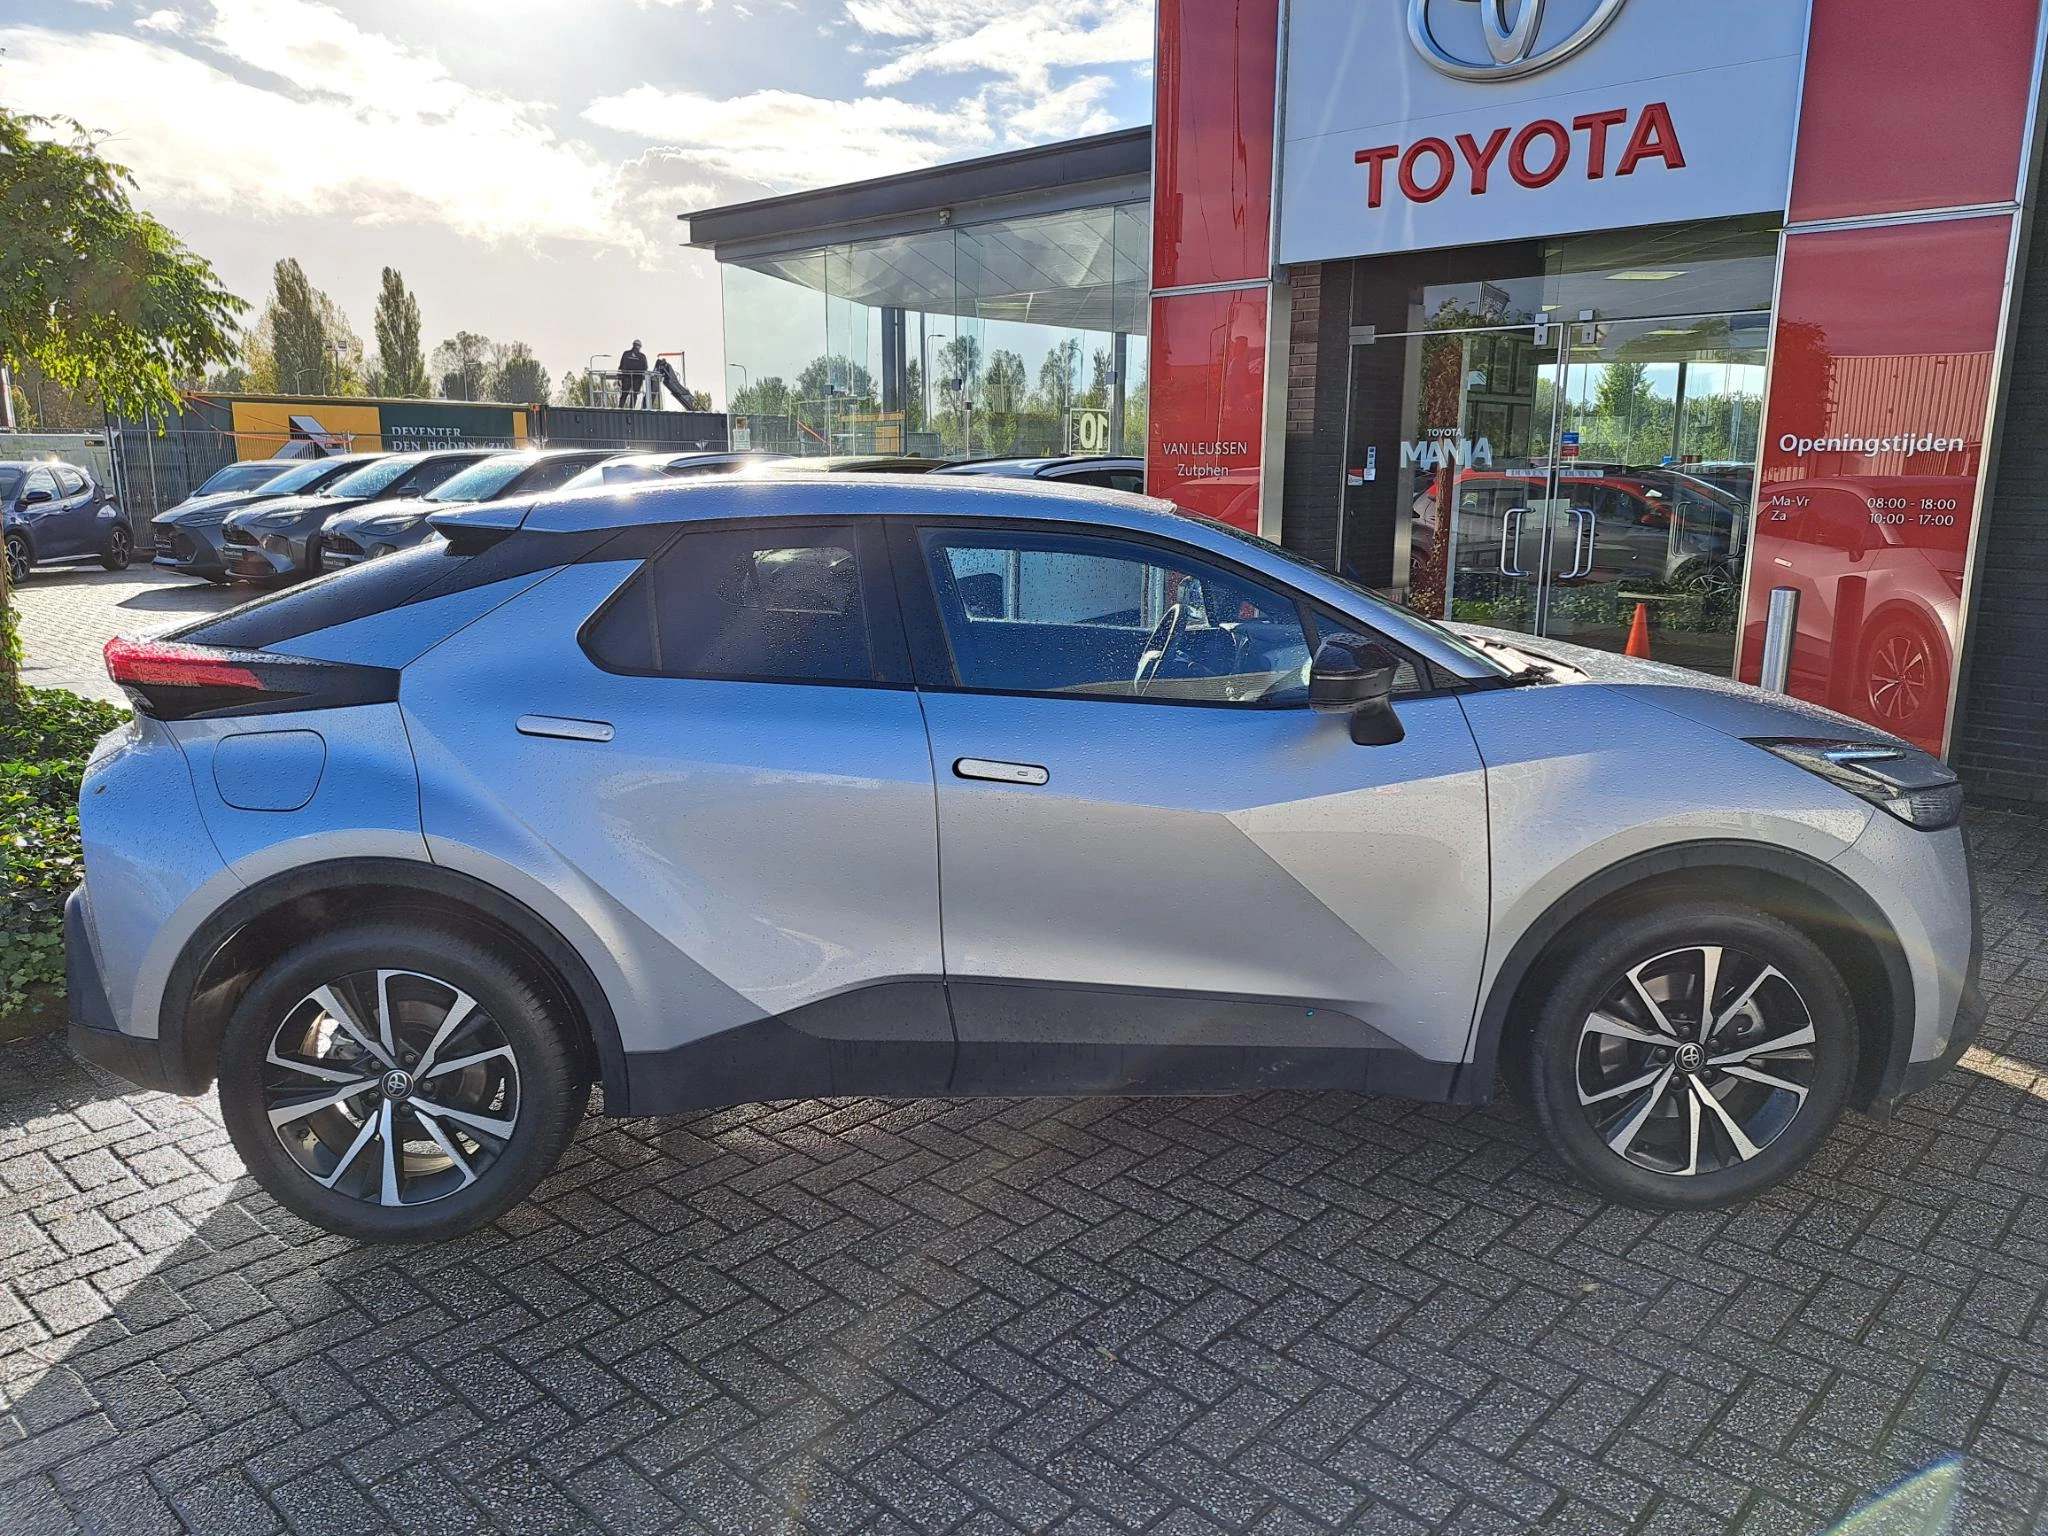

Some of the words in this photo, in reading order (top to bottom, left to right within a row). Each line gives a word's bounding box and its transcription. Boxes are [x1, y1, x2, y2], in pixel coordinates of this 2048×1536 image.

[1354, 102, 1686, 208] TOYOTA
[391, 426, 461, 437] DEVENTER
[1427, 428, 1463, 437] TOYOTA
[393, 440, 421, 452] DEN
[427, 441, 476, 450] HOORN
[483, 440, 512, 449] (ZH)
[1163, 442, 1188, 455] VAN
[1192, 441, 1247, 455] LEUSSEN
[1779, 433, 1964, 457] Openingstijden
[1400, 437, 1492, 470] MANIA
[1178, 463, 1229, 479] Zutphen
[1772, 495, 1810, 507] Ma-Vr
[1867, 497, 1907, 509] 08:00
[1920, 498, 1957, 510] 18:00
[1771, 510, 1787, 521] Za
[1870, 513, 1905, 525] 10:00
[1919, 514, 1954, 526] 17:00
